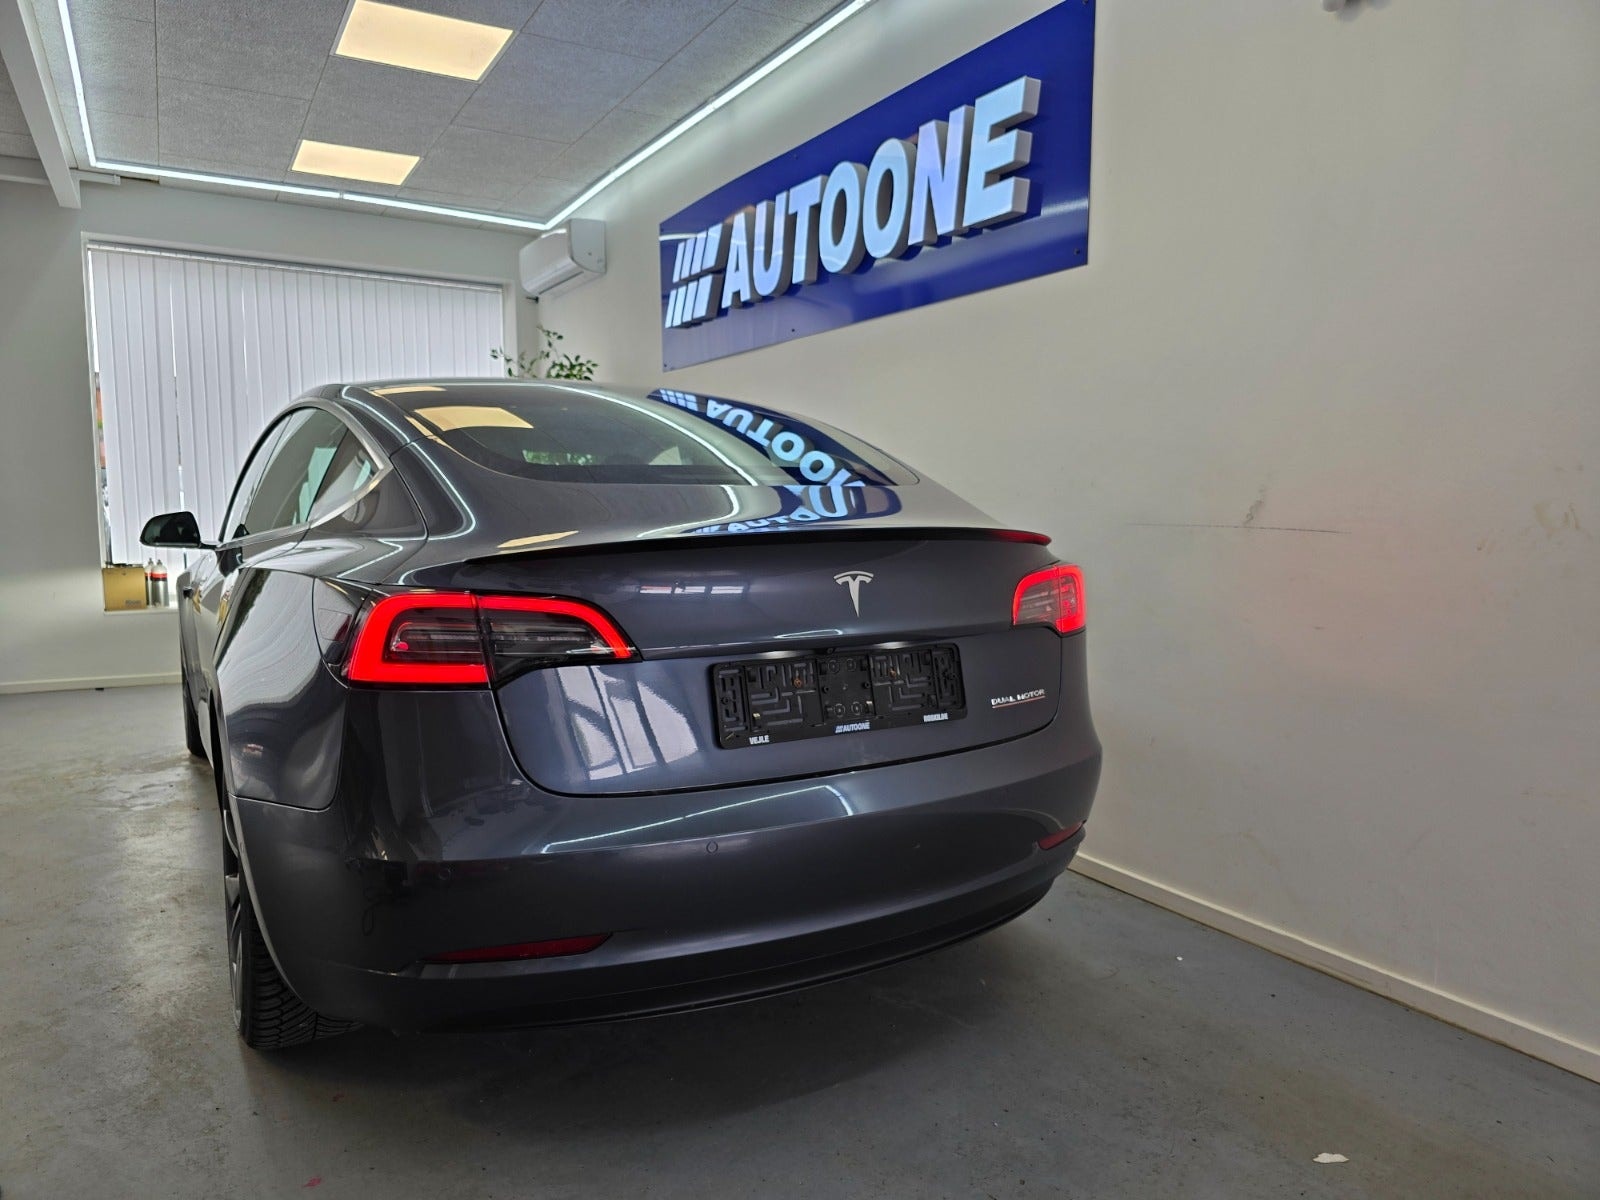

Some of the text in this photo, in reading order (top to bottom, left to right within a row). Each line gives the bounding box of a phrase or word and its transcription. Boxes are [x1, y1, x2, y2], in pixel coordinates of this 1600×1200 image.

[721, 75, 1041, 310] AUTOONE
[991, 688, 1046, 706] DUAL MOTOR
[842, 721, 870, 733] AUTOONE
